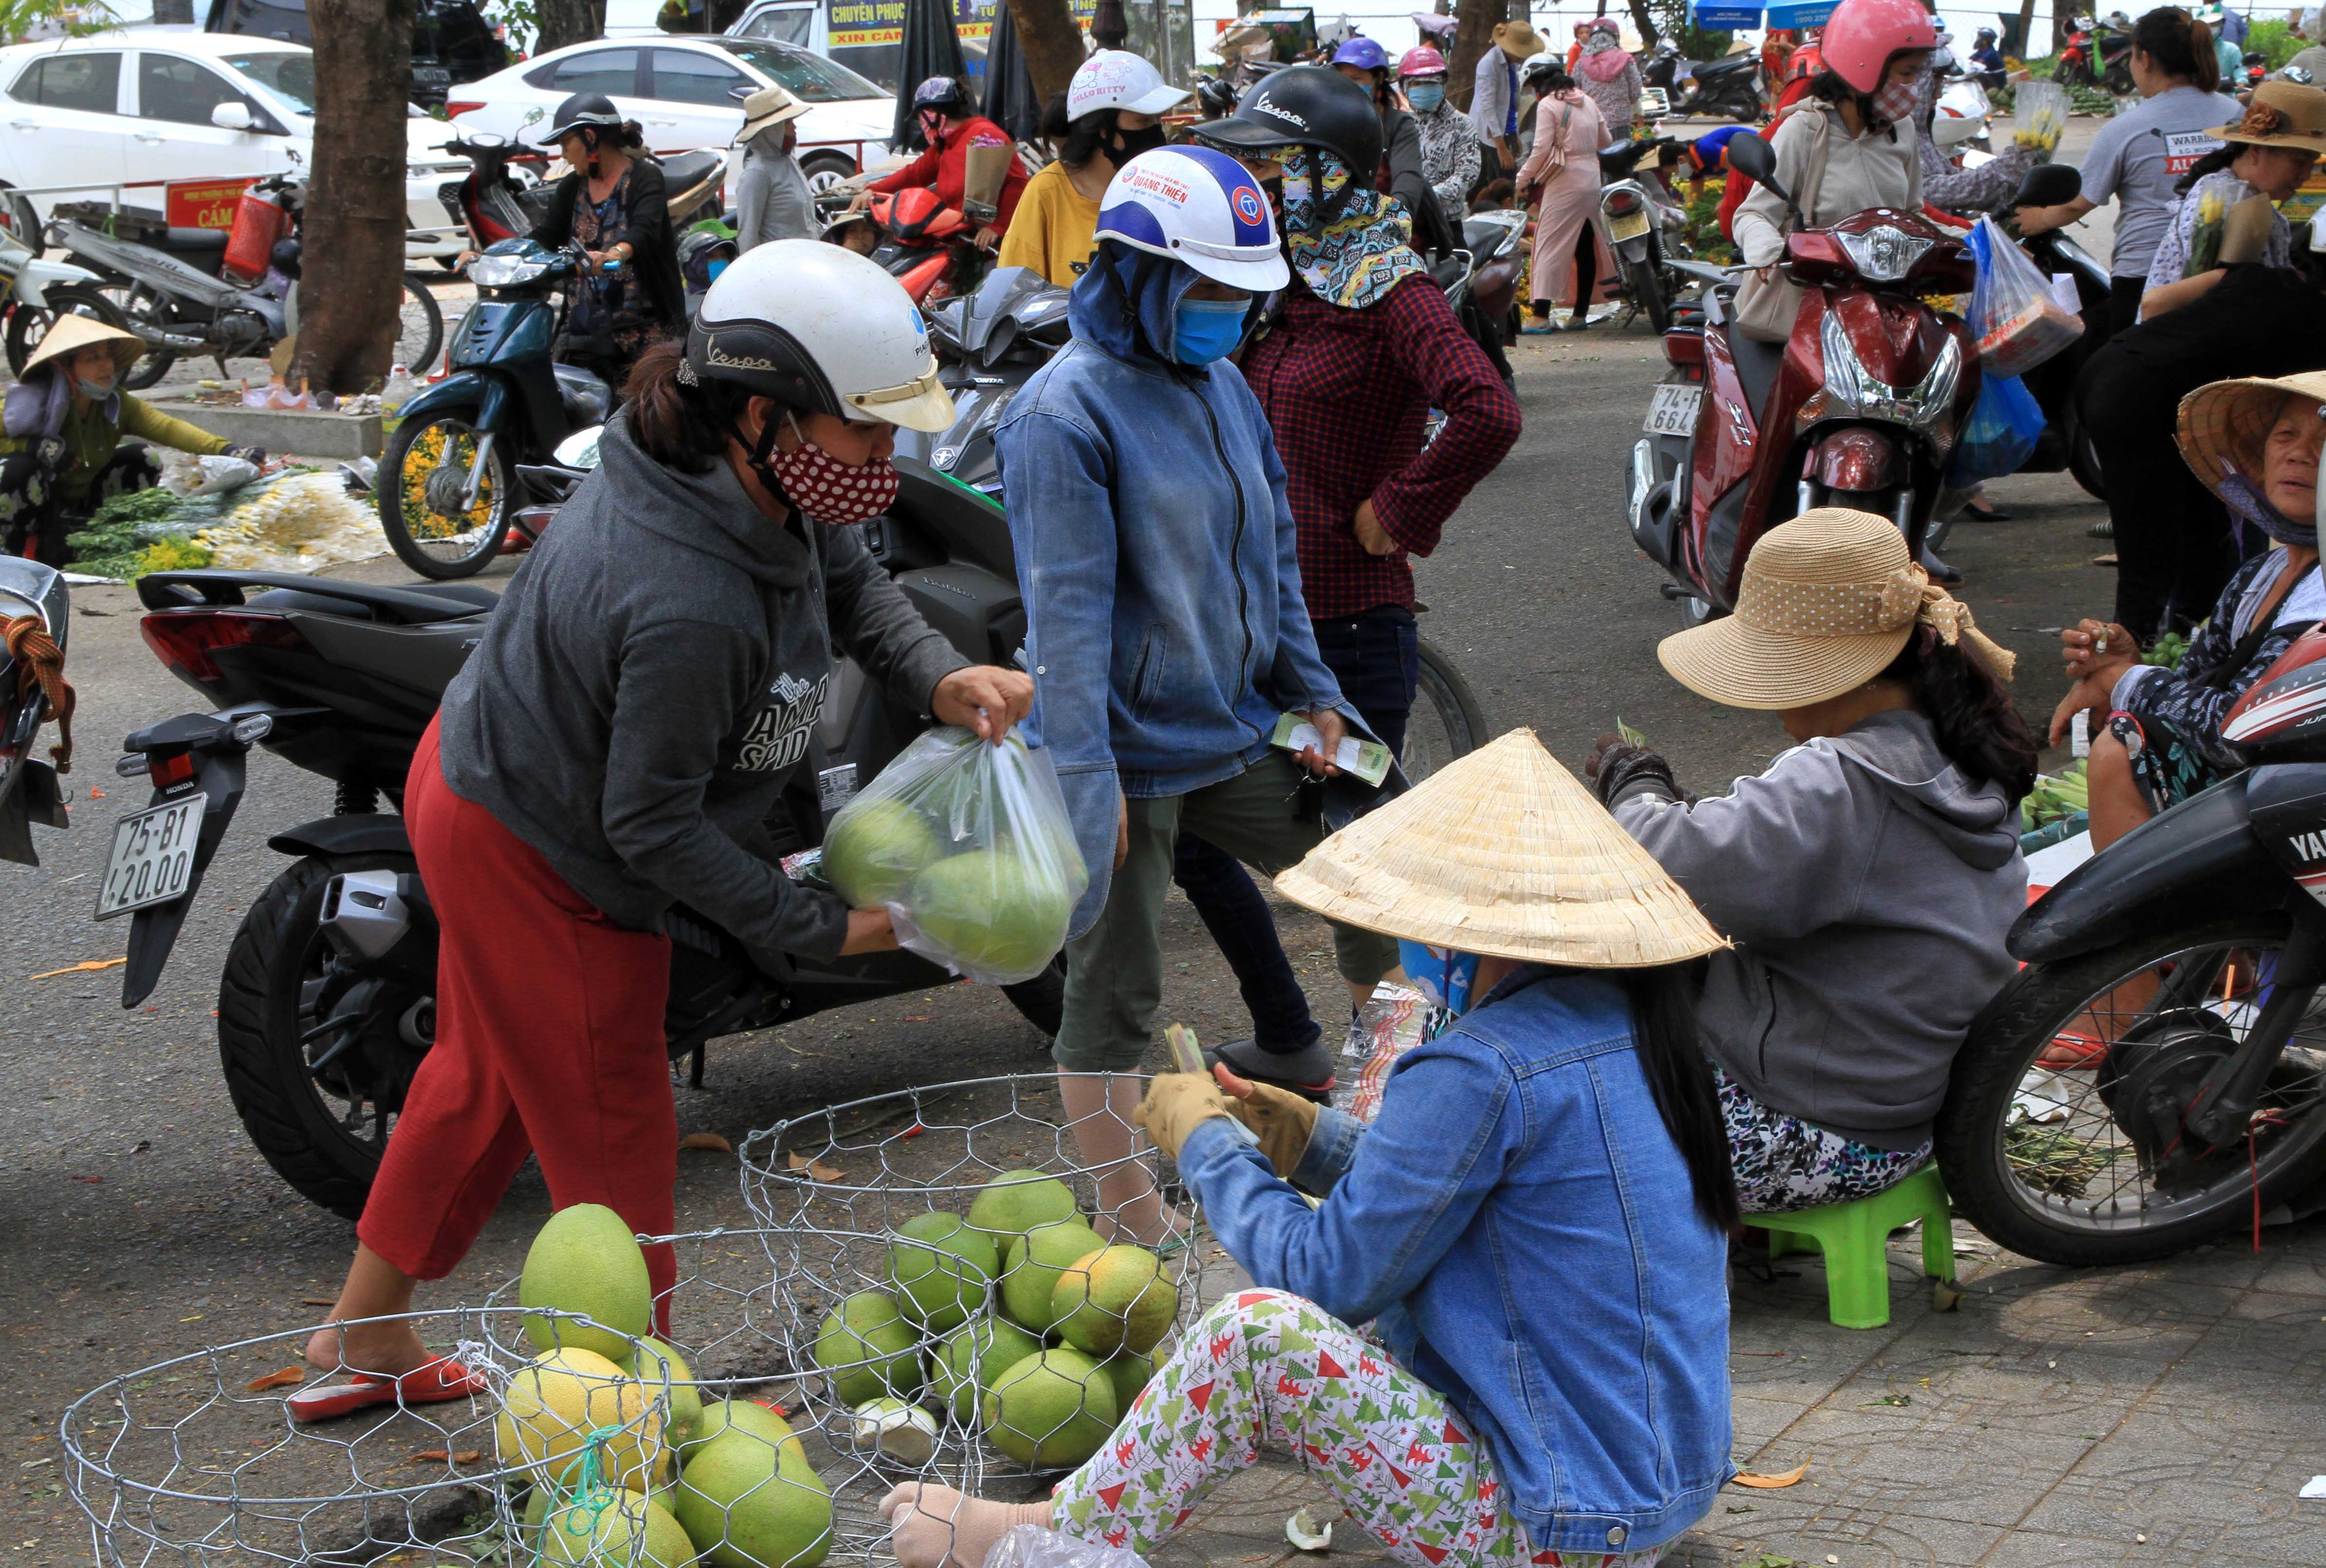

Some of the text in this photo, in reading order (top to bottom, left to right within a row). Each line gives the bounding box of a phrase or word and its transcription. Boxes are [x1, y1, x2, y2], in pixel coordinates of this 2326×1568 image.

[832, 2, 906, 23] CHUYÊN PHỤC
[837, 34, 865, 43] XIN
[1096, 85, 1125, 94] KITTY
[2172, 134, 2220, 145] WARRIO
[1133, 175, 1161, 192] QUANG
[1160, 184, 1188, 204] THIỆN
[706, 334, 777, 371] Vespa
[1654, 410, 1698, 430] 664
[770, 672, 810, 704] the
[732, 719, 819, 771] SPID
[166, 781, 194, 795] HONDA
[2289, 829, 2326, 861] YA
